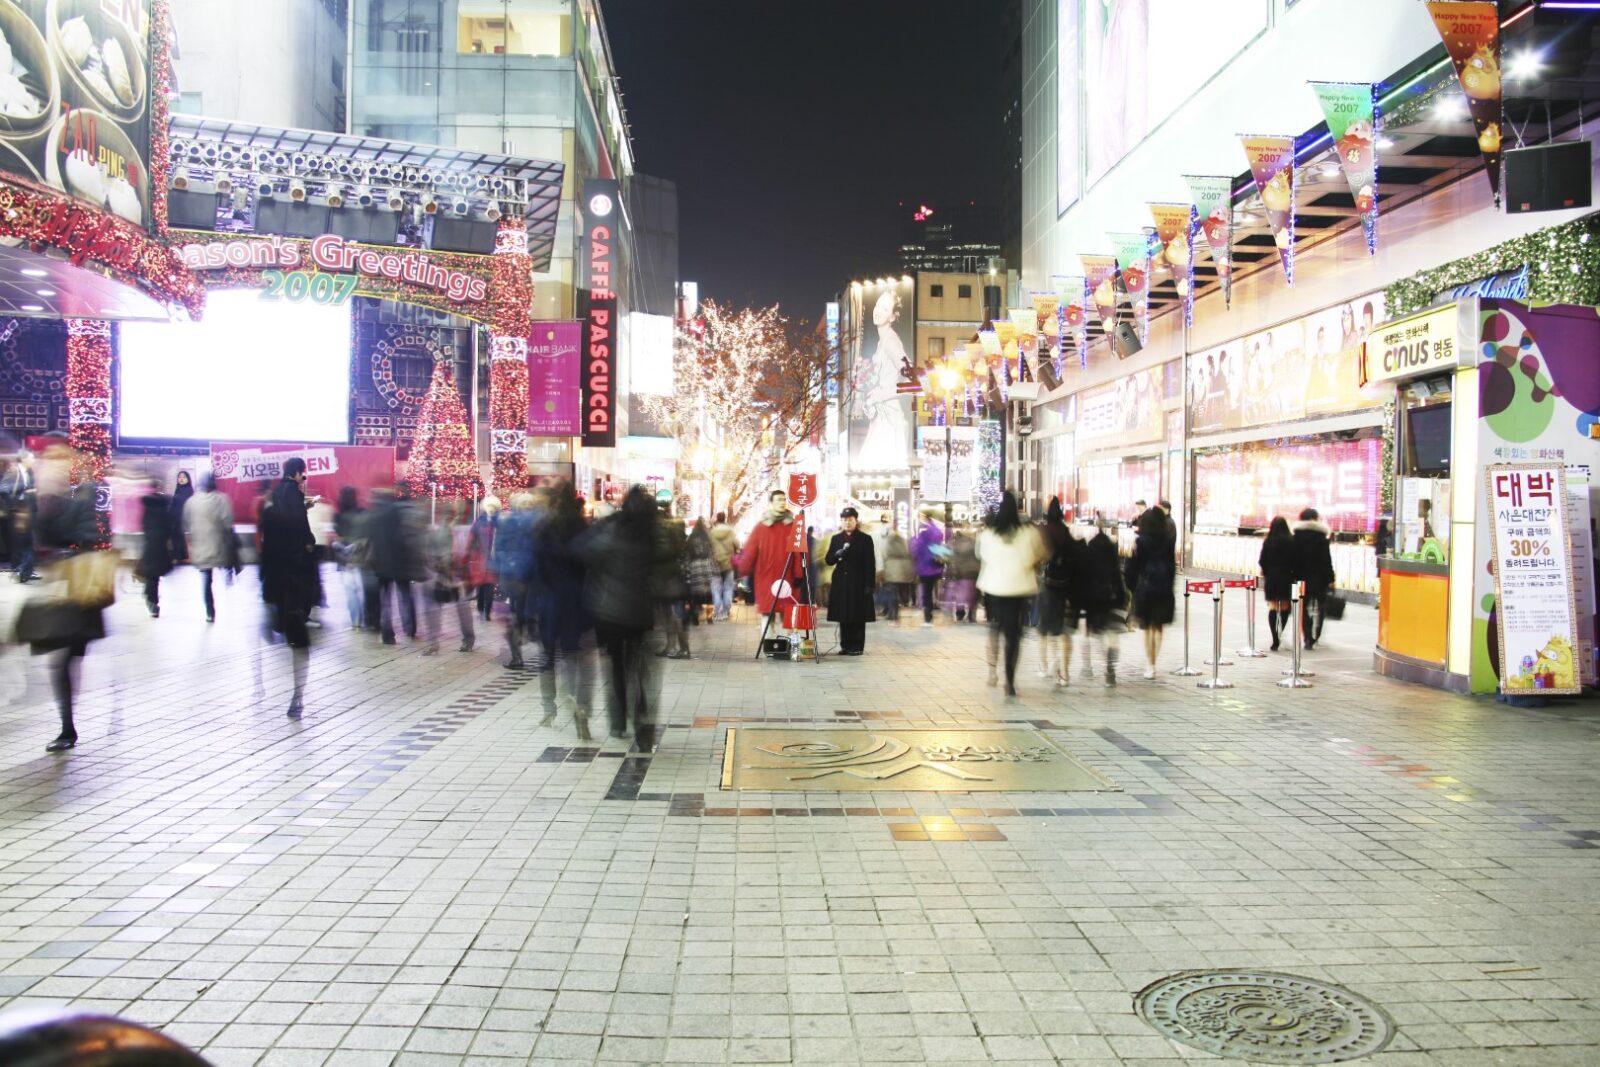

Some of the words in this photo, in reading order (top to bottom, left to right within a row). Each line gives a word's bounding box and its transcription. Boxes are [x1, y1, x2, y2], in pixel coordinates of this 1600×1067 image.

[1452, 23, 1482, 35] 2007
[1333, 103, 1359, 113] 2007
[60, 100, 97, 167] ZAO
[1258, 154, 1281, 163] 2007
[1201, 192, 1221, 200] 2007
[914, 213, 926, 221] SK
[1163, 218, 1183, 226] 2007
[171, 236, 299, 269] ason's
[312, 234, 487, 301] Greetings
[260, 270, 359, 305] 2007
[551, 344, 578, 354] BANK
[1433, 337, 1454, 361] 명동
[589, 309, 610, 433] PASCUCCI
[242, 461, 281, 479] 자오핑
[797, 475, 809, 505] 구세군
[1496, 471, 1555, 507] 대박
[1507, 528, 1524, 537] 구매
[1510, 539, 1551, 557] 30%
